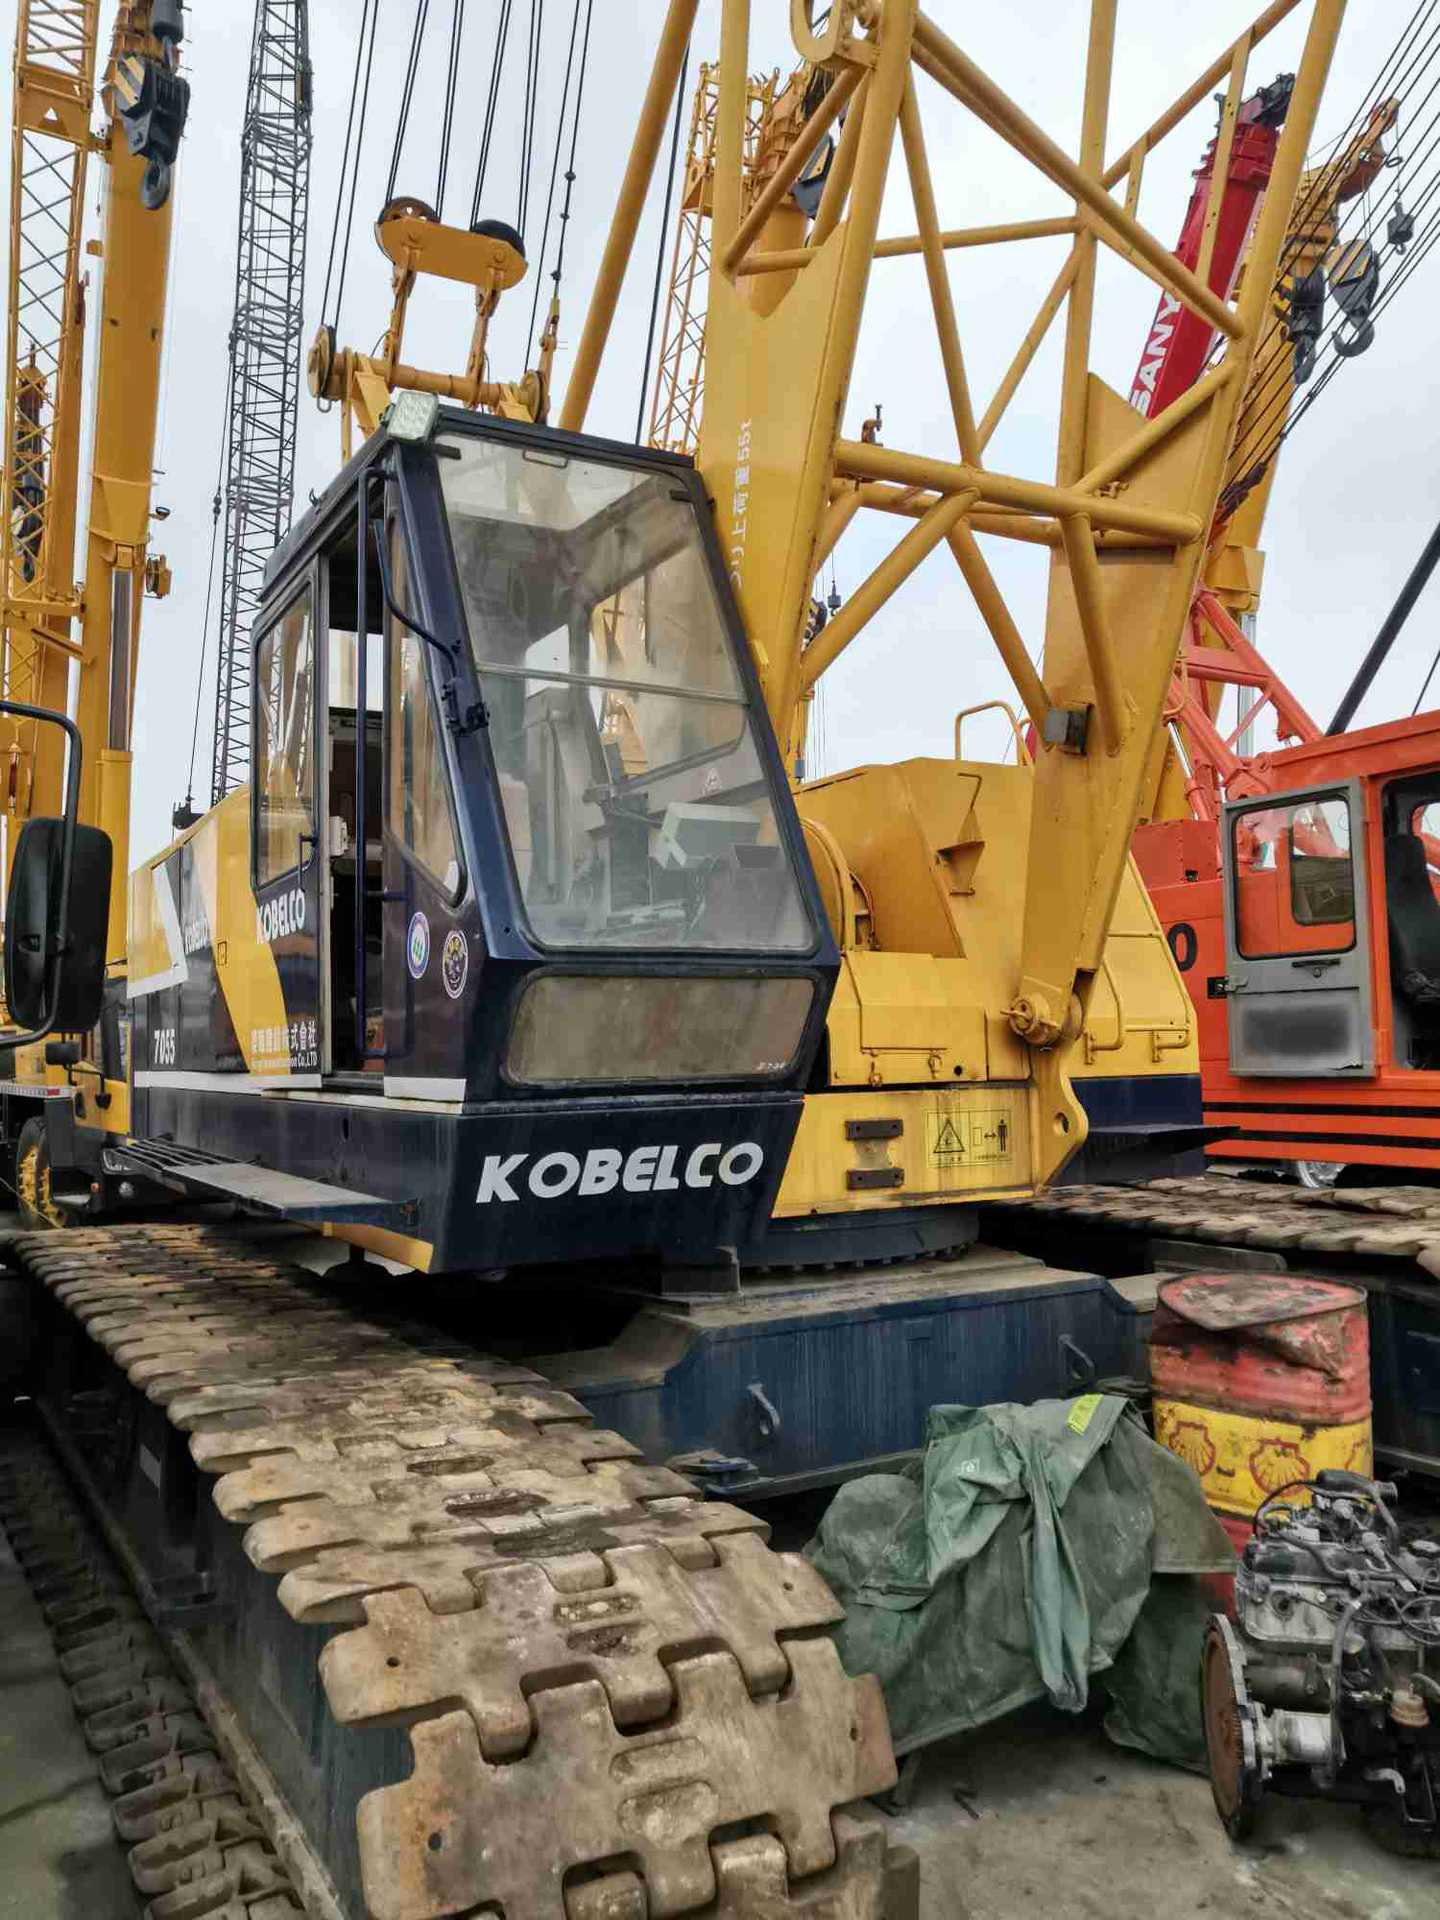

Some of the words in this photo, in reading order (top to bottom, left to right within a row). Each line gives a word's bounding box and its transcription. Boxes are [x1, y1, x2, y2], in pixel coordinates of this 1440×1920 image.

[256, 888, 306, 945] KOBELCO
[153, 1028, 176, 1066] 7055
[476, 1142, 764, 1204] KOBELCO
